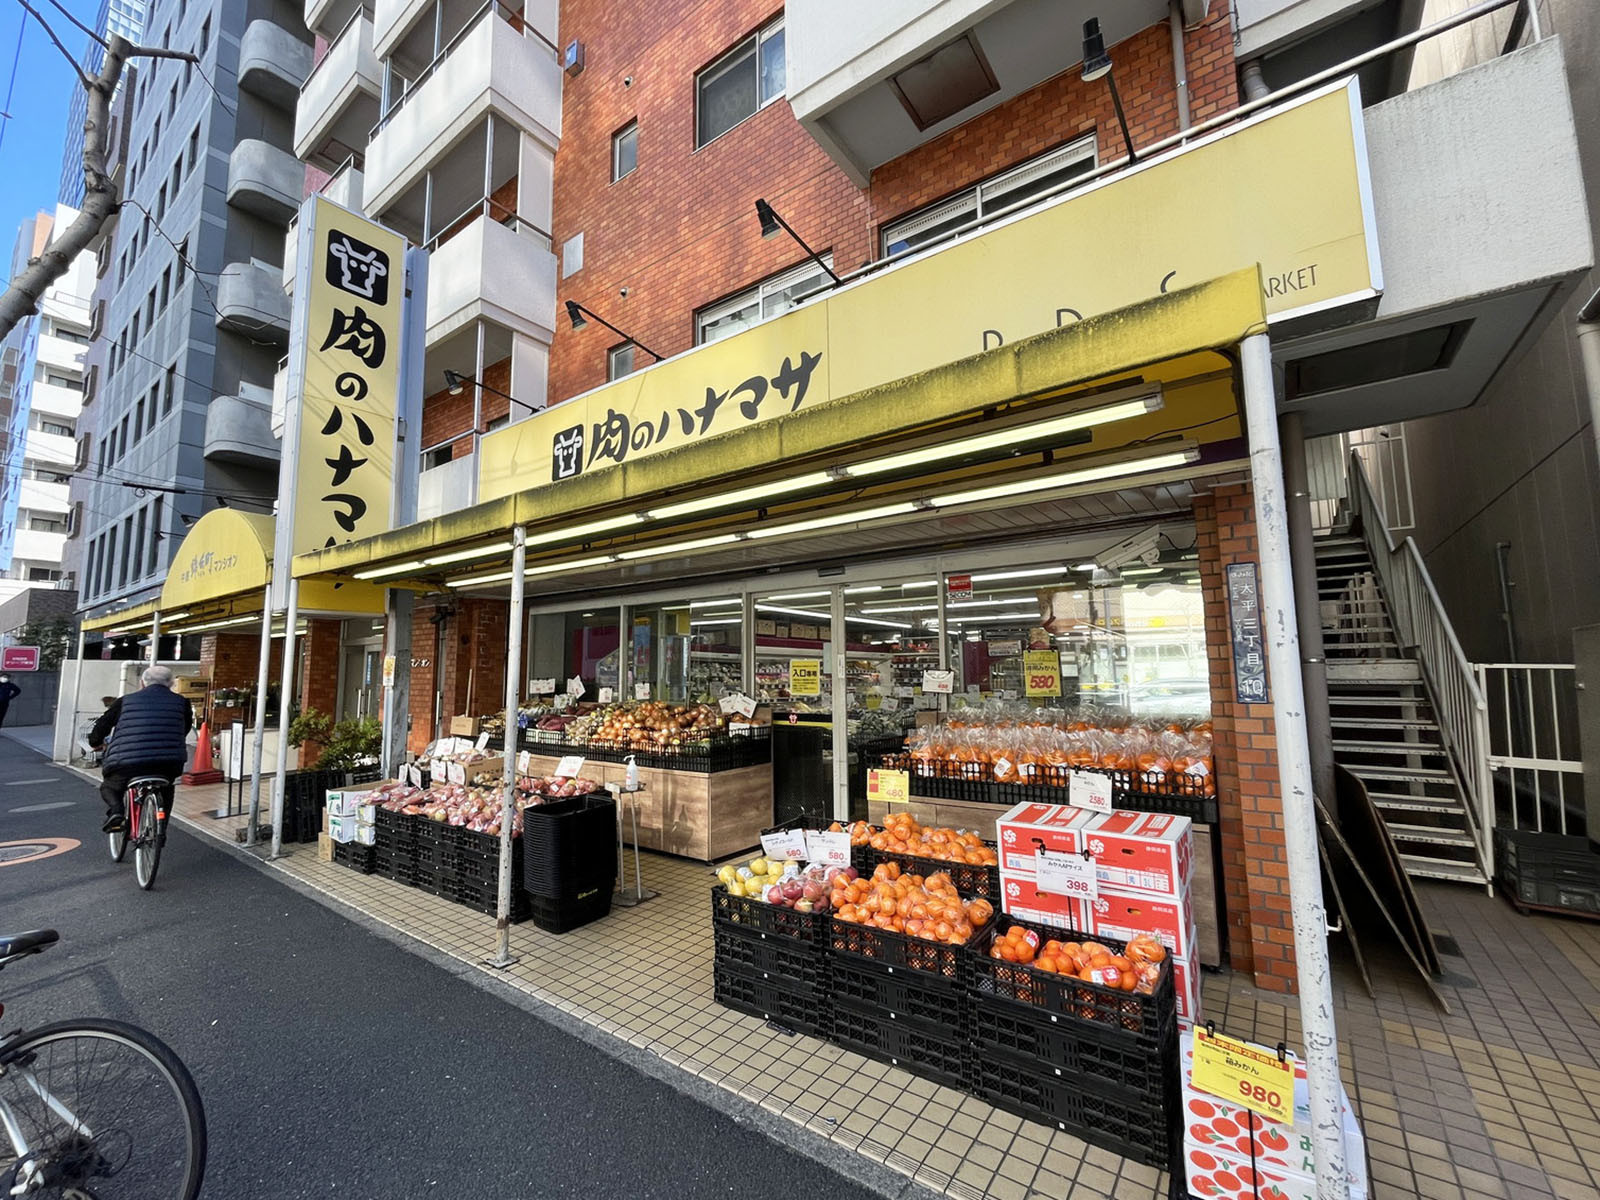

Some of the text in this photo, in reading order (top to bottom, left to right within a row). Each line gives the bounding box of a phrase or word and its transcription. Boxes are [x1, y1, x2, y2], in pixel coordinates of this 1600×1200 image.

[586, 351, 823, 469] 肉のハナマサ
[1240, 583, 1259, 665] 太平三丁目
[1030, 675, 1054, 689] 580
[786, 848, 801, 857] 580
[828, 851, 844, 861] 580
[1066, 879, 1089, 892] 398
[1239, 1079, 1282, 1108] 980
